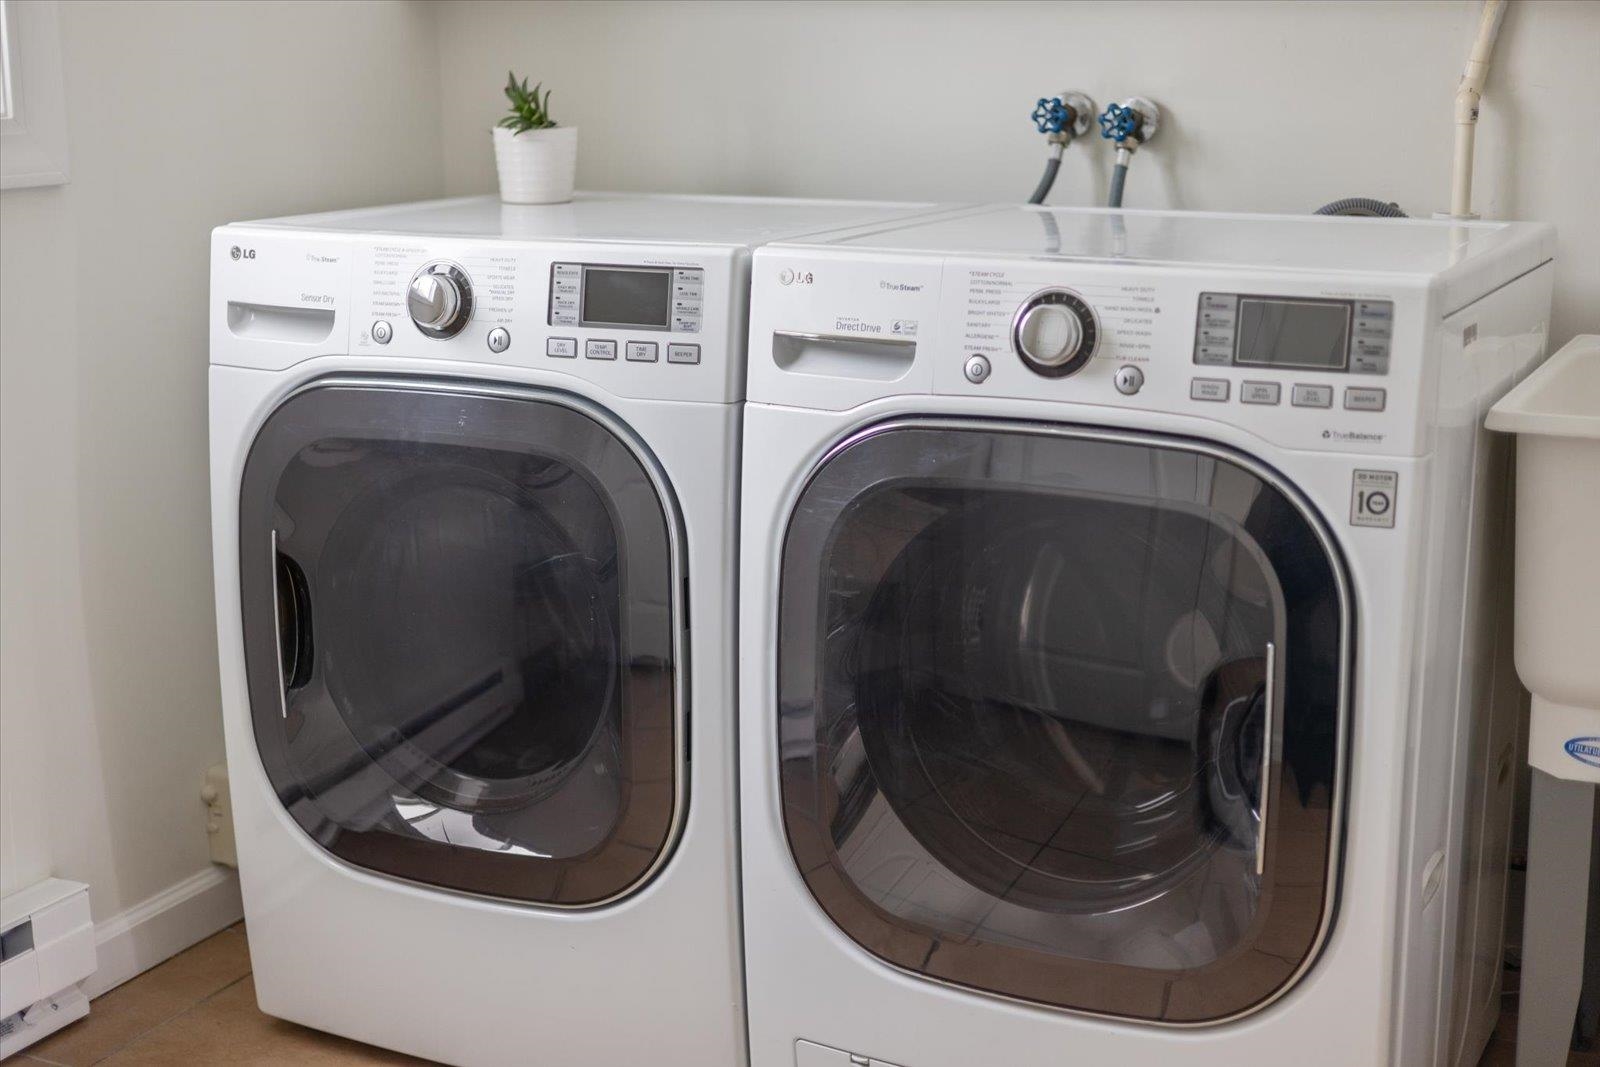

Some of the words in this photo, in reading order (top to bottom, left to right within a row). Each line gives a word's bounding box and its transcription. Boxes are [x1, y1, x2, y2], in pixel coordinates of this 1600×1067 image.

[243, 249, 256, 259] LG
[797, 271, 814, 284] LG
[301, 293, 322, 303] Sensor
[323, 295, 334, 304] Dry
[836, 321, 859, 332] Direct
[860, 323, 881, 334] Drive
[1358, 491, 1390, 515] 10
[1568, 743, 1600, 757] UTILATU
